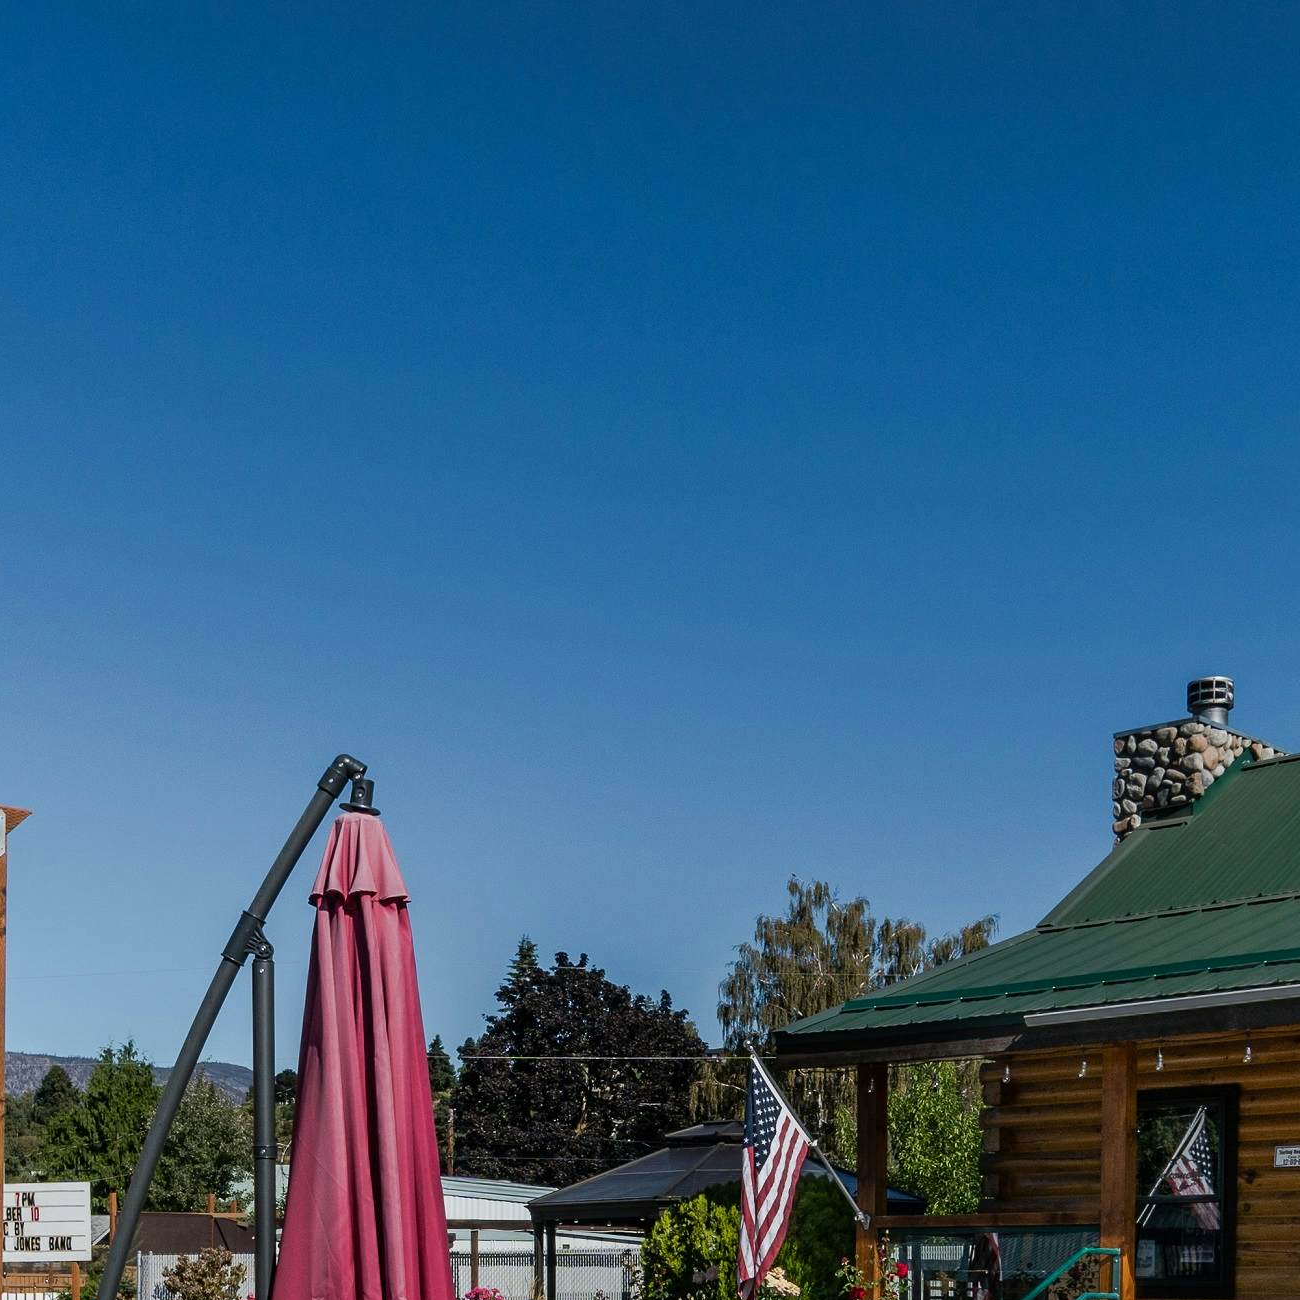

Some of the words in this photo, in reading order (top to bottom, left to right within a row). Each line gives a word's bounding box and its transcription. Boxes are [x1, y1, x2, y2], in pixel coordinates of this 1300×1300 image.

[31, 1207, 40, 1221] 10
[14, 1222, 25, 1236] BY
[14, 1236, 41, 1251] JONES
[49, 1236, 72, 1251] BAND
